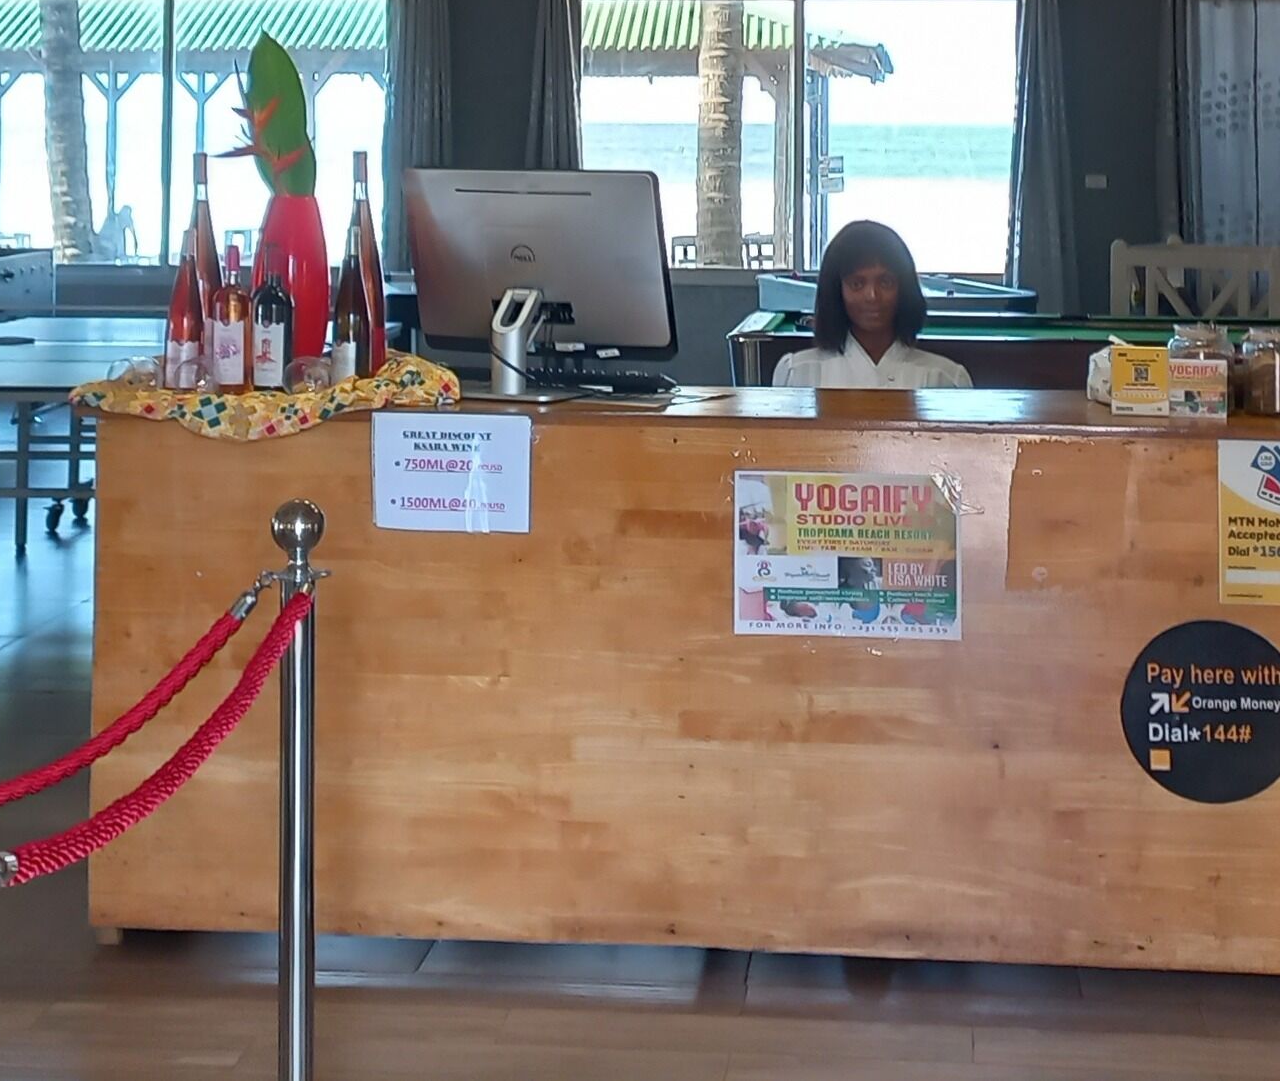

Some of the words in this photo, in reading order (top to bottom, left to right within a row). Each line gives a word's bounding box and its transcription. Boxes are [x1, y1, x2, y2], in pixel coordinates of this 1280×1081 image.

[402, 430, 438, 440] GREAT
[413, 442, 449, 451] KSARA
[794, 482, 933, 513] YOGAIFY
[796, 513, 866, 526] STUDIO
[873, 515, 913, 527] LIVE
[1228, 516, 1256, 527] MTN
[797, 527, 854, 538] TROPICANA
[857, 528, 890, 539] BEACH
[894, 529, 933, 540] RESORT
[1227, 546, 1250, 556] Dial
[888, 562, 908, 575] LED
[910, 562, 924, 575] BY
[888, 574, 911, 586] LISA
[914, 574, 948, 587] WHITE
[814, 623, 846, 631] INFO:
[1147, 663, 1184, 689] Pay
[1191, 664, 1235, 685] here
[1192, 696, 1237, 712] Orange
